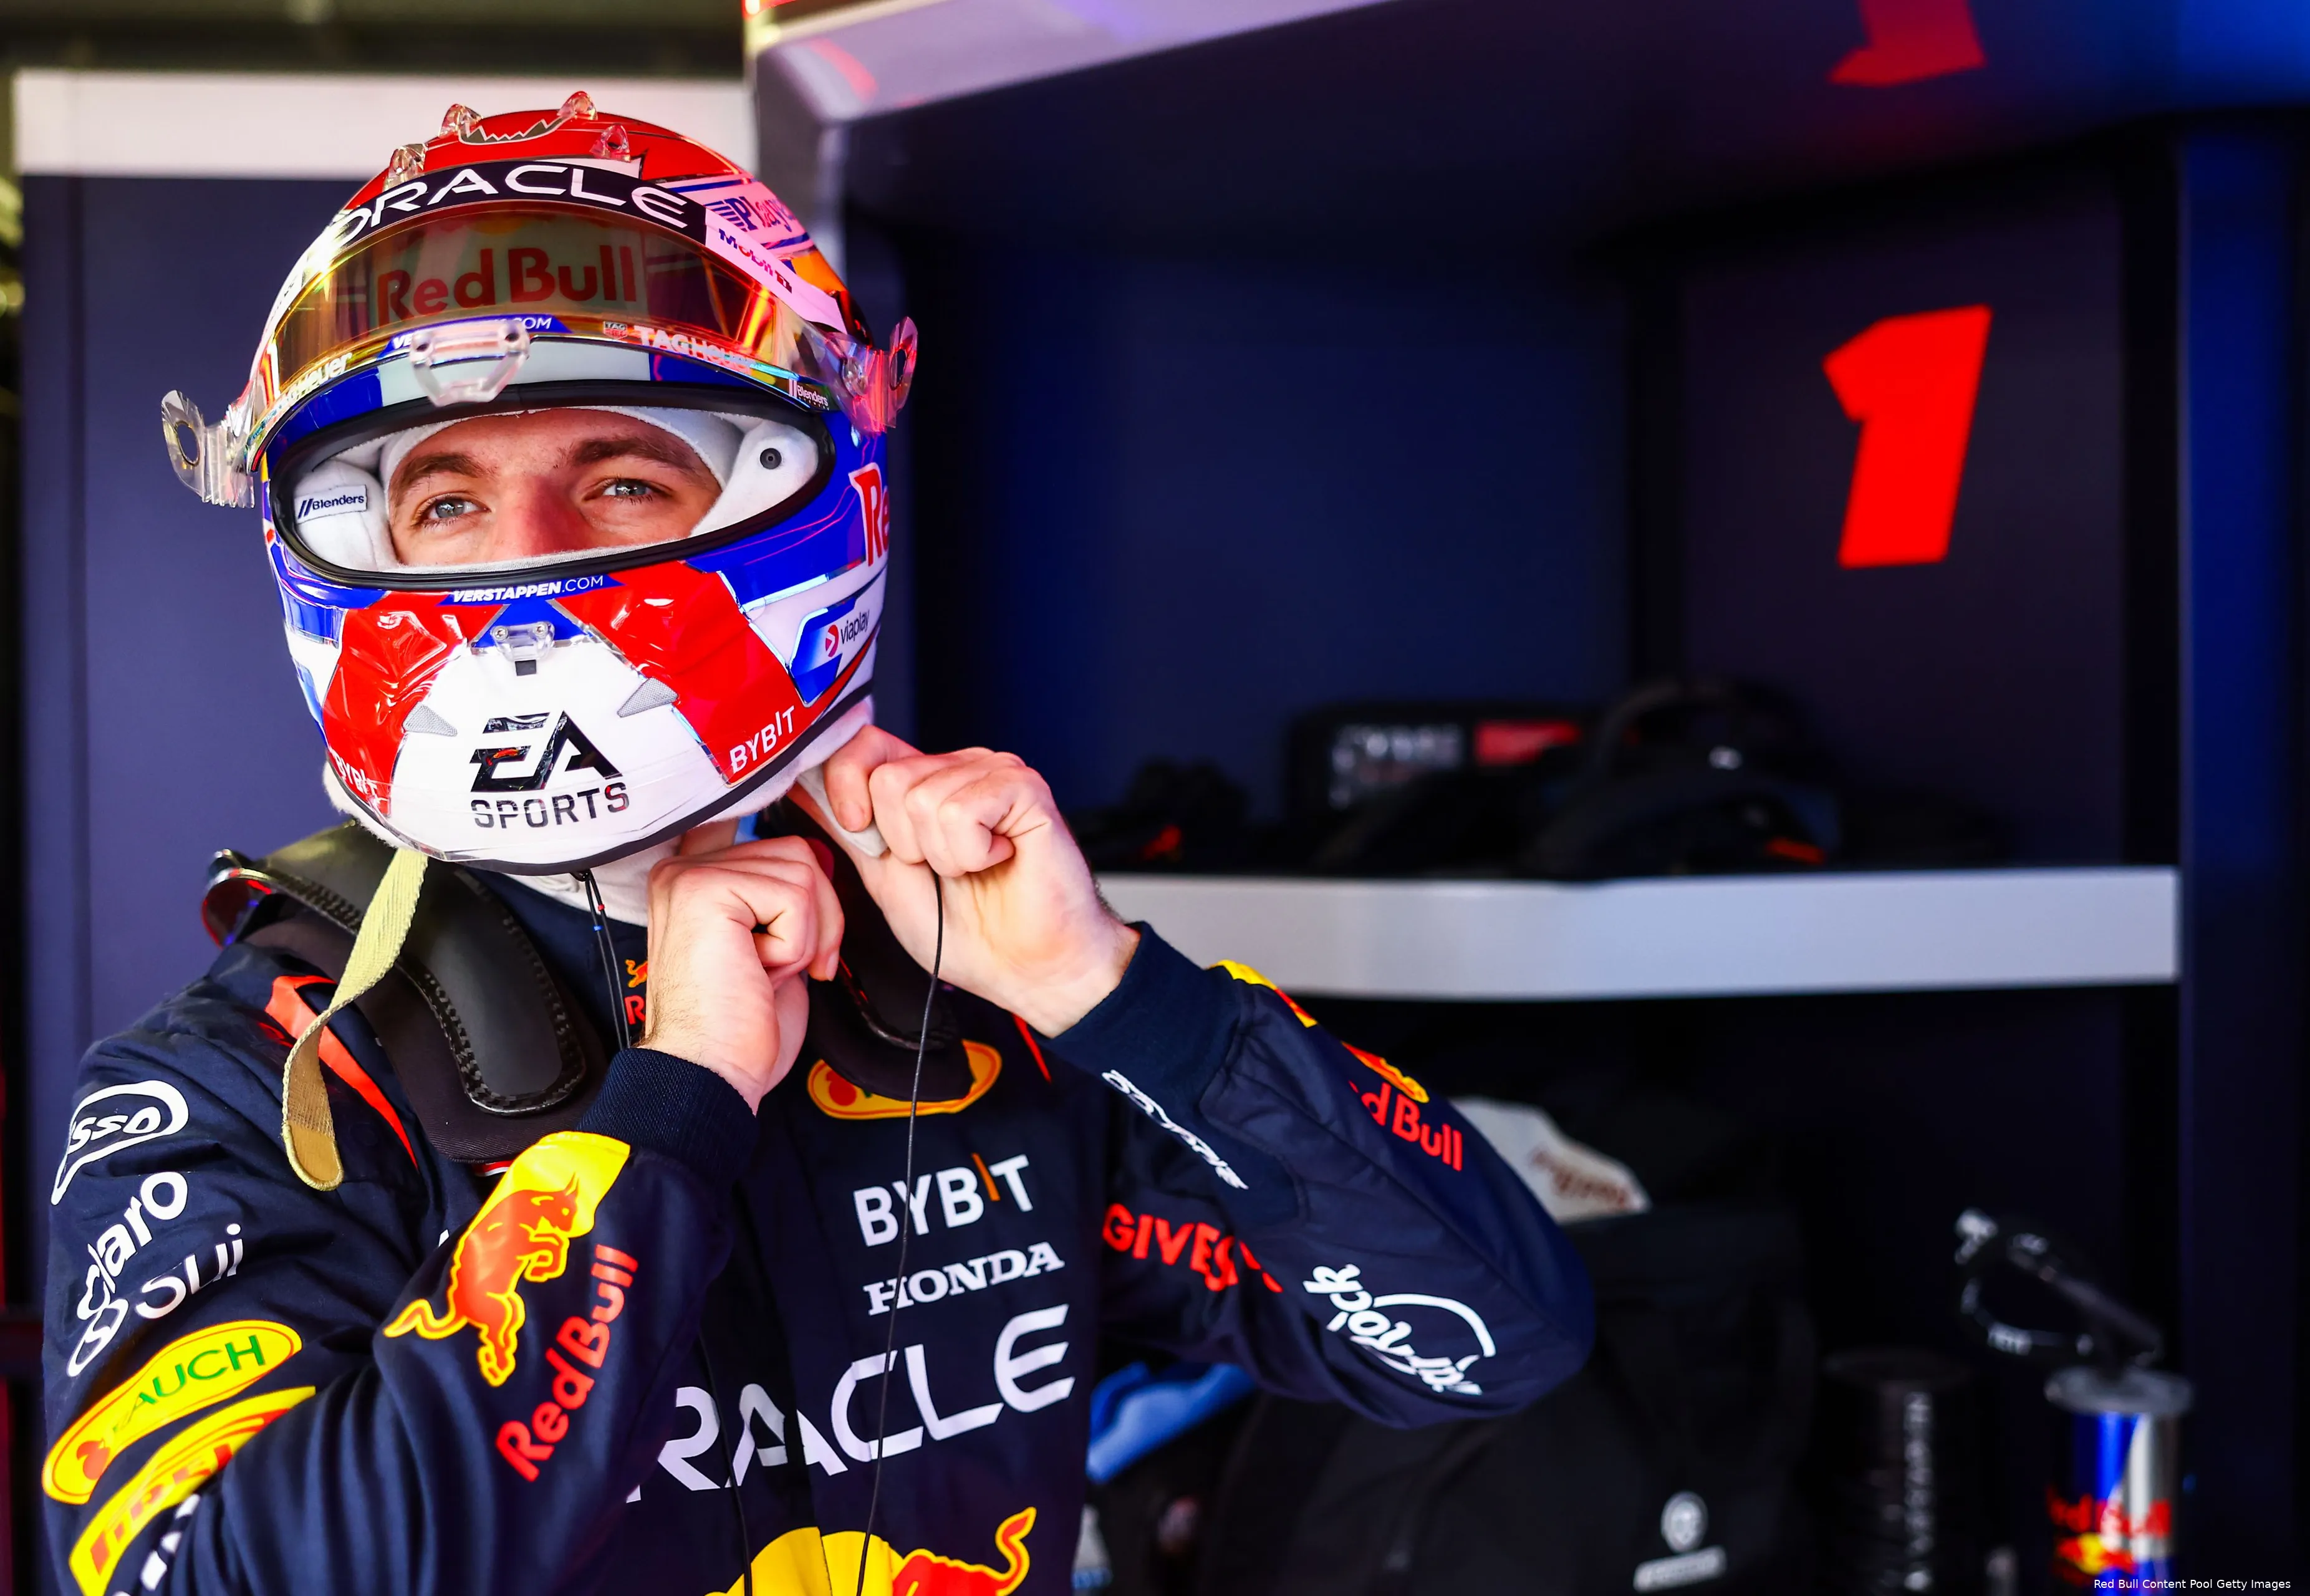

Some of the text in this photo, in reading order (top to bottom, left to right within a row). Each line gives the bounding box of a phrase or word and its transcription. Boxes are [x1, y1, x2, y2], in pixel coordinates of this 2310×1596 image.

[321, 163, 688, 257] ORACLE
[378, 245, 637, 323] Red Bull
[1822, 303, 1992, 569] 1
[849, 463, 890, 567] Re
[453, 575, 604, 603] VERSTAPPEN.COM
[840, 608, 870, 645] viaplay
[469, 709, 623, 792] EA
[728, 705, 796, 774] BYBIT
[470, 781, 630, 829] SPORTS
[67, 1106, 162, 1155] sso
[1392, 1093, 1463, 1172] Bull
[852, 1152, 1034, 1247] BYBIT
[863, 1241, 1065, 1315] HONDA
[113, 1334, 266, 1433] AUCH
[494, 1244, 639, 1483] Red Bull
[625, 1304, 1076, 1503] RACLE
